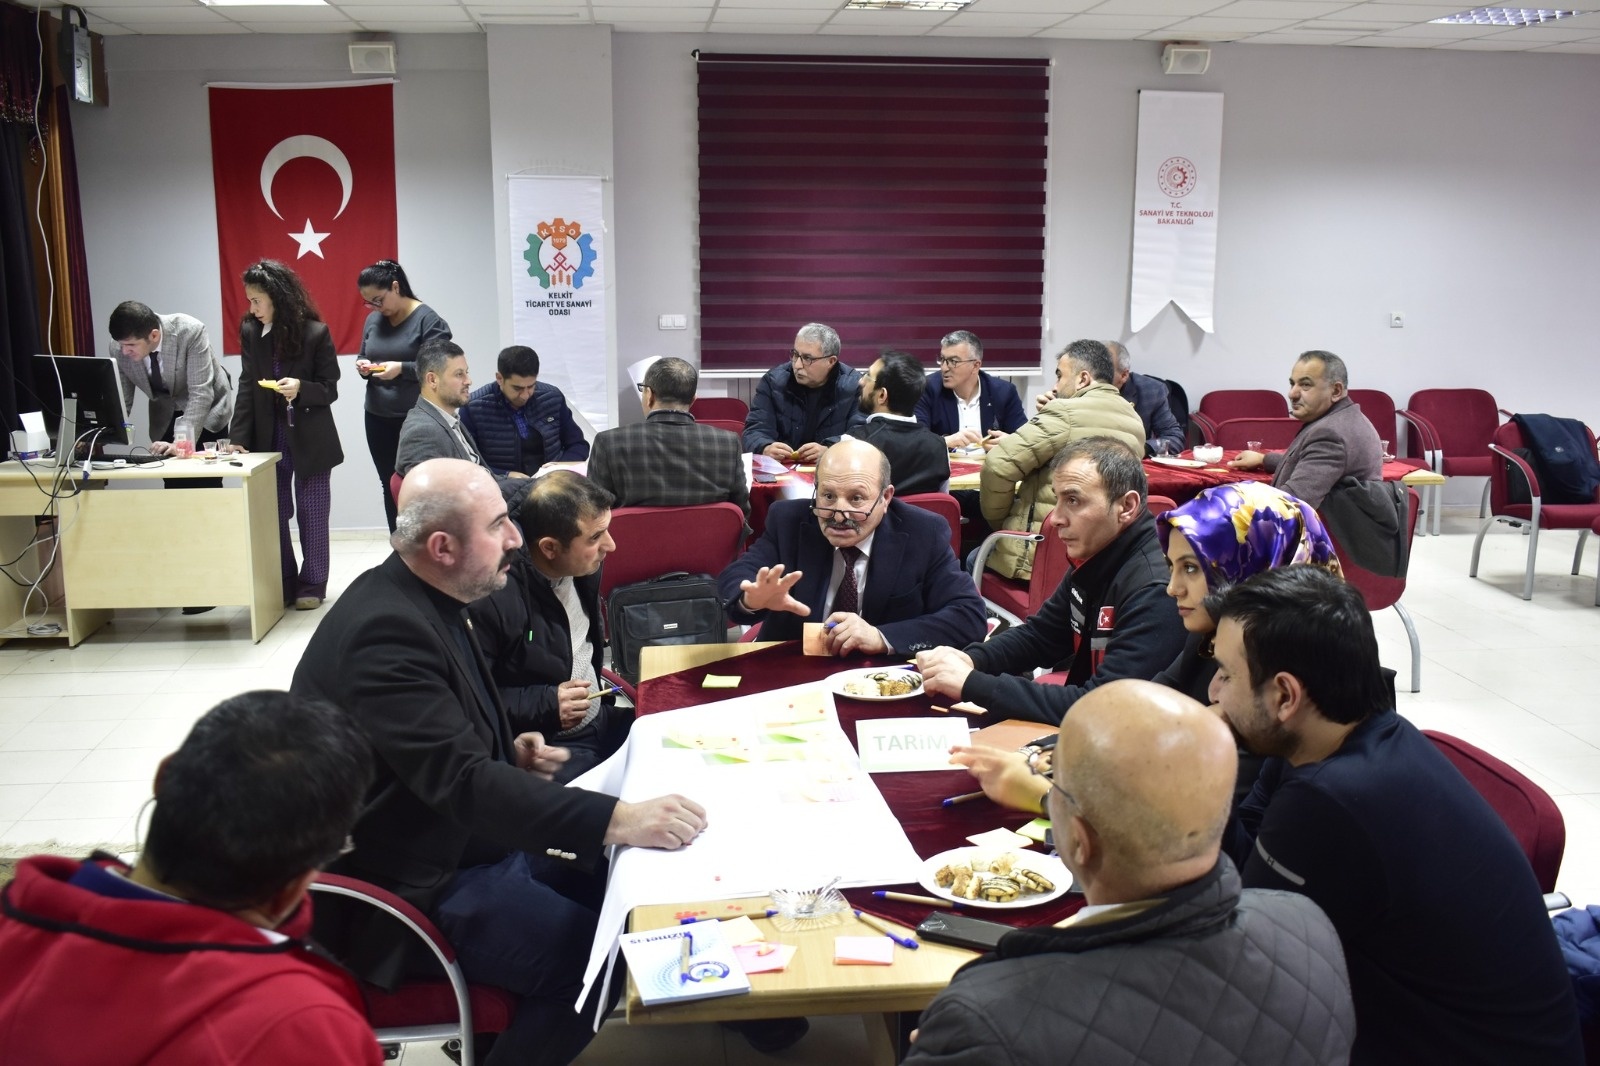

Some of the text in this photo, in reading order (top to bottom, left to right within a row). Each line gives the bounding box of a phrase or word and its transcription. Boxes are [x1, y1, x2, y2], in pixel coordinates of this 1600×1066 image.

[1139, 209, 1164, 217] SANAYİ
[1176, 210, 1214, 218] TEKNOLOJİ
[1157, 217, 1194, 225] BAKANLIĞI
[540, 225, 576, 237] KTSO
[548, 291, 573, 299] KELKİT
[525, 300, 554, 308] TİCARET
[566, 300, 592, 308] SANAYİ
